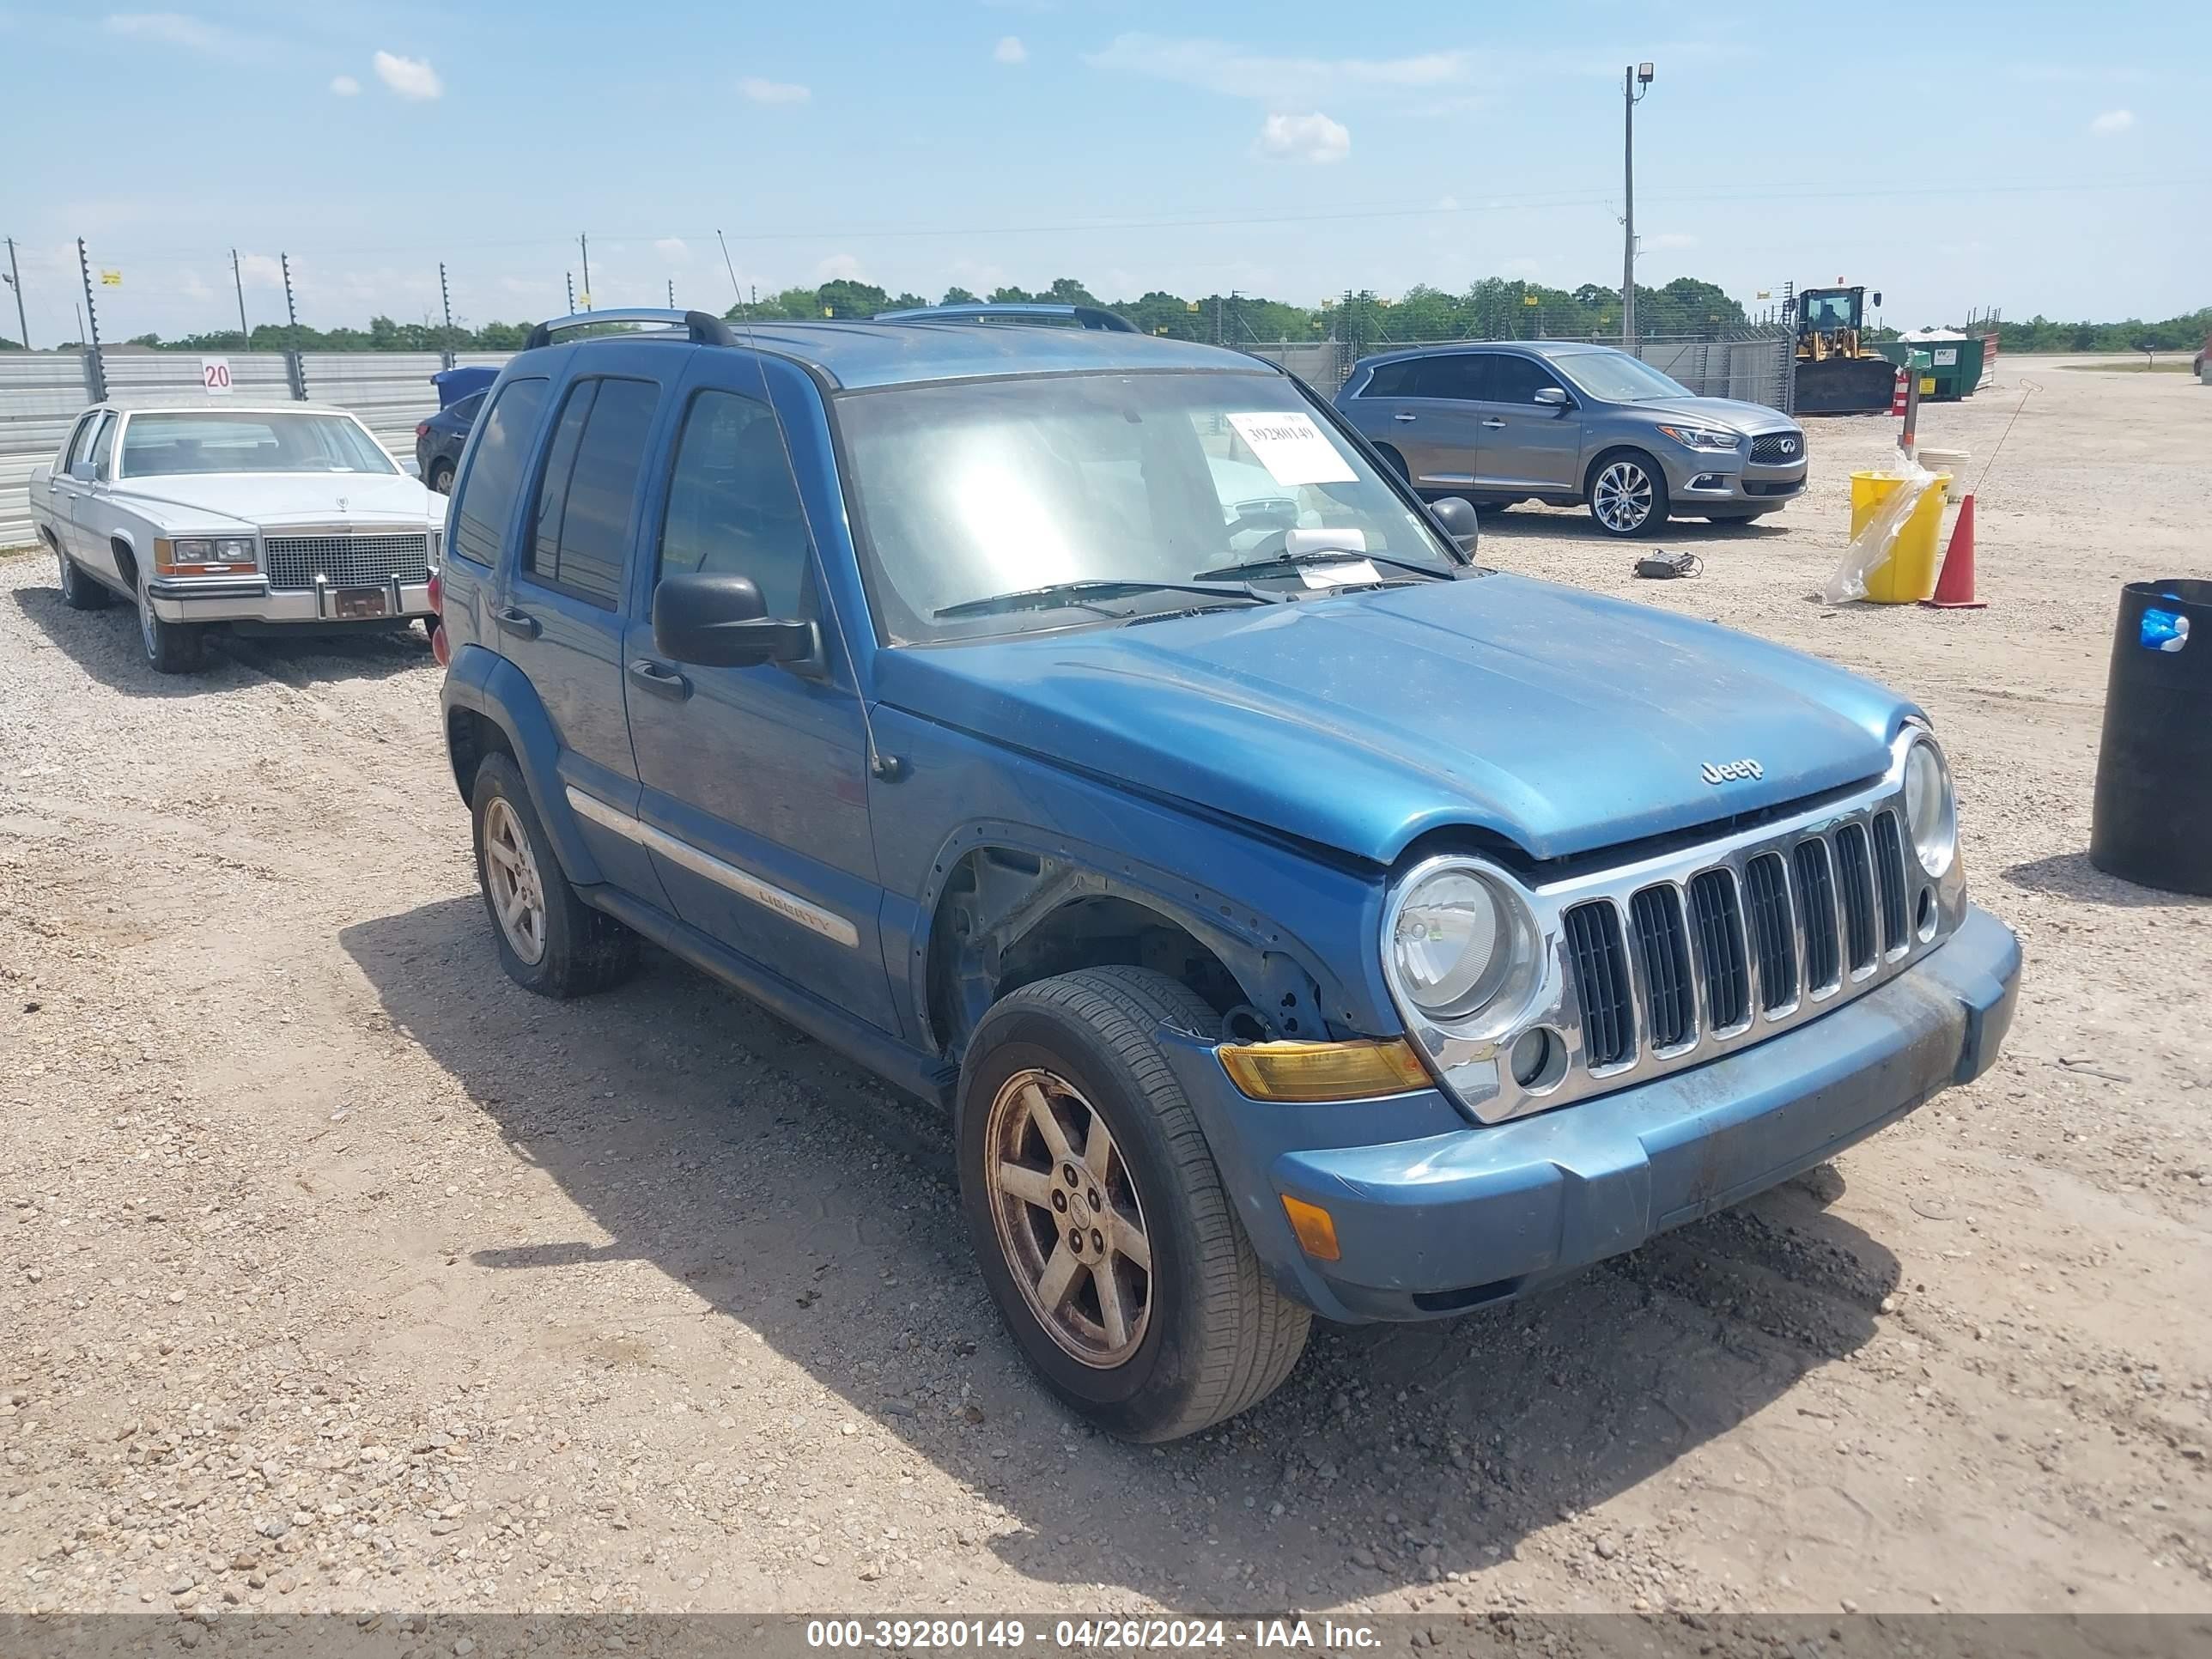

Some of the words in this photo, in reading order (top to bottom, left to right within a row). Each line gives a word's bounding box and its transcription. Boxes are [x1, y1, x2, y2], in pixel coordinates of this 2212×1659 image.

[205, 365, 229, 387] 20
[1700, 758, 1765, 786] Jeep
[758, 890, 830, 931] LIBERTY
